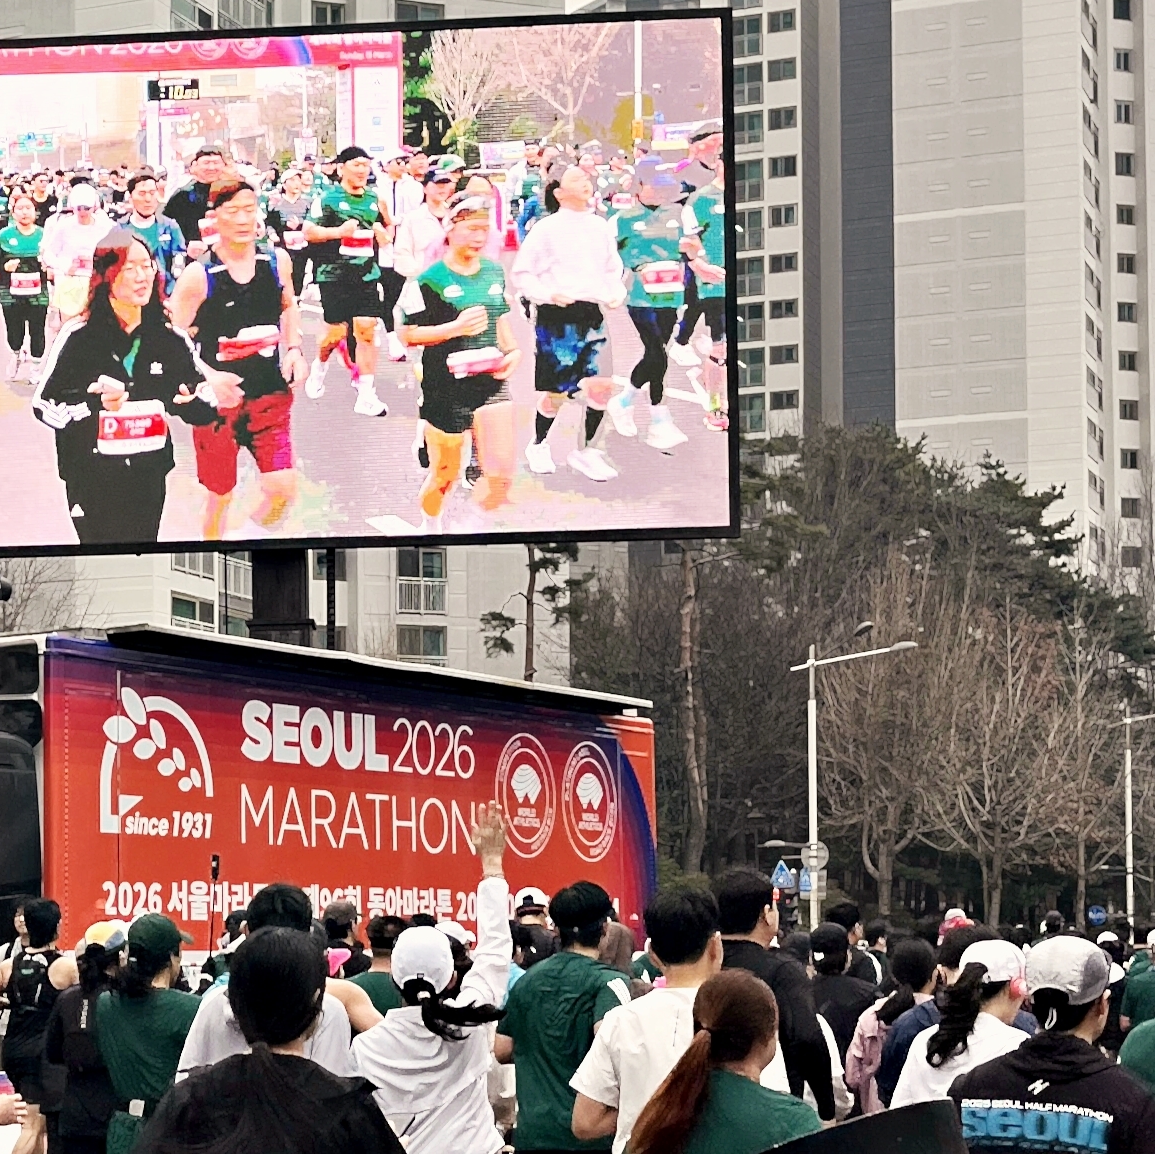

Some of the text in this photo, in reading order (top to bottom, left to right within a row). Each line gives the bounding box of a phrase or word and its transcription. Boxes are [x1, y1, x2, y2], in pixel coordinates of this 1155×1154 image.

[241, 700, 389, 772] SEOUL
[393, 717, 476, 779] 2026
[124, 810, 213, 839] since 1931
[240, 783, 477, 856] MARATHON
[102, 880, 162, 916] 2026
[167, 879, 269, 922] 서울마라
[367, 886, 454, 922] 동아마라톤
[961, 1107, 1108, 1150] seoul
[992, 1100, 1023, 1109] SEOUL
[1025, 1102, 1052, 1111] HALF
[1053, 1104, 1114, 1123] MARATHON
